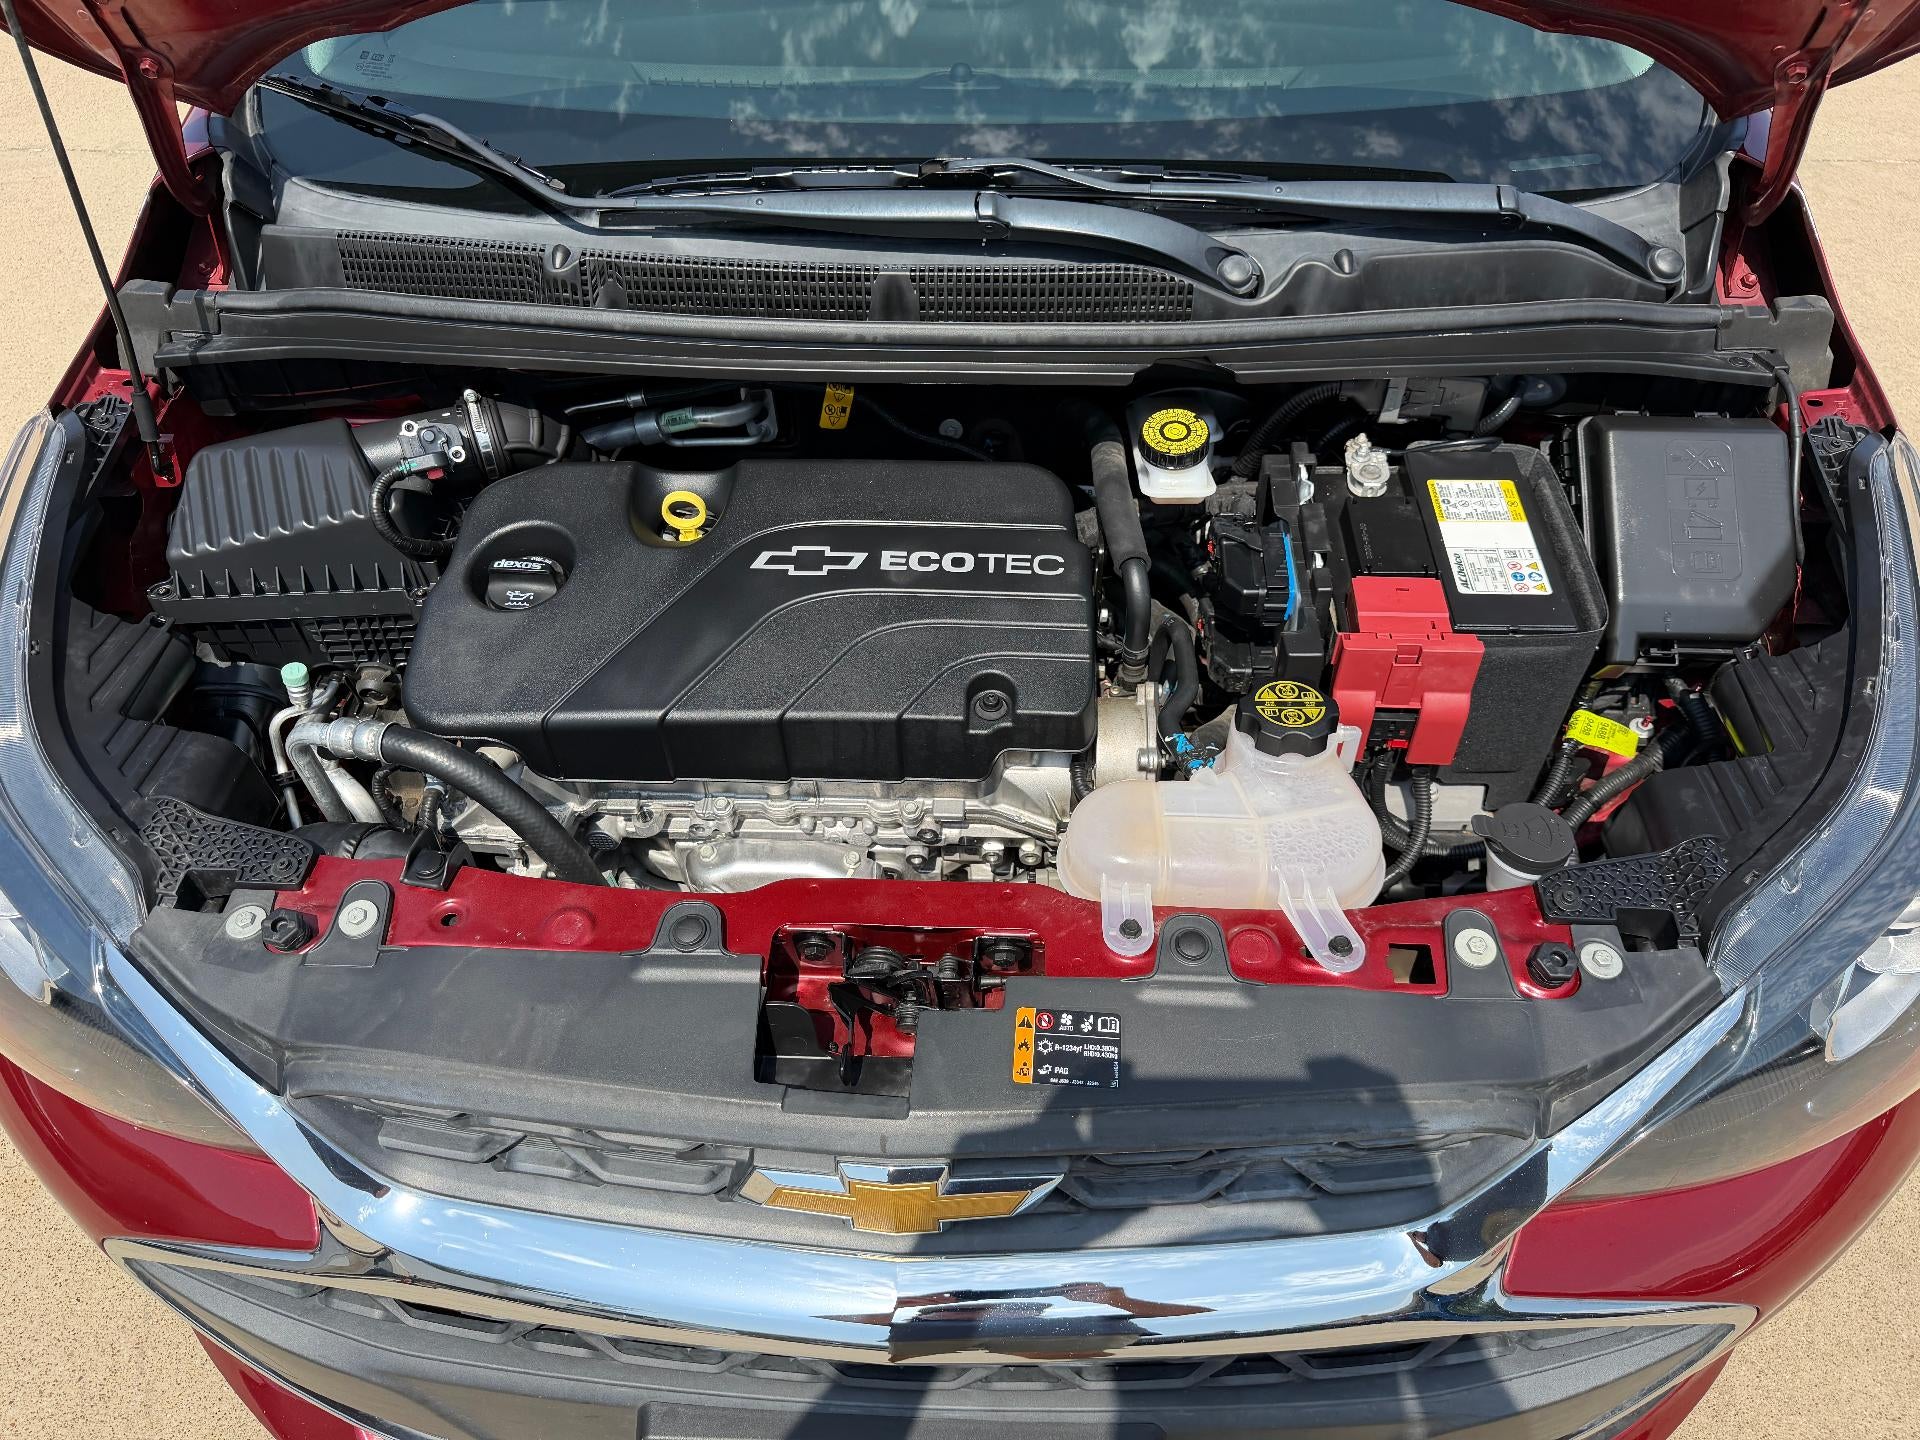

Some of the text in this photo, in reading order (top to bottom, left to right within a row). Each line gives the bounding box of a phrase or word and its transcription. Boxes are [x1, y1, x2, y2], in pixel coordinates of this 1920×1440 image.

[493, 559, 543, 570] dexos
[880, 550, 1065, 575] ECOTEC
[1453, 553, 1470, 590] ACDelco
[1054, 1066, 1069, 1075] PAG
